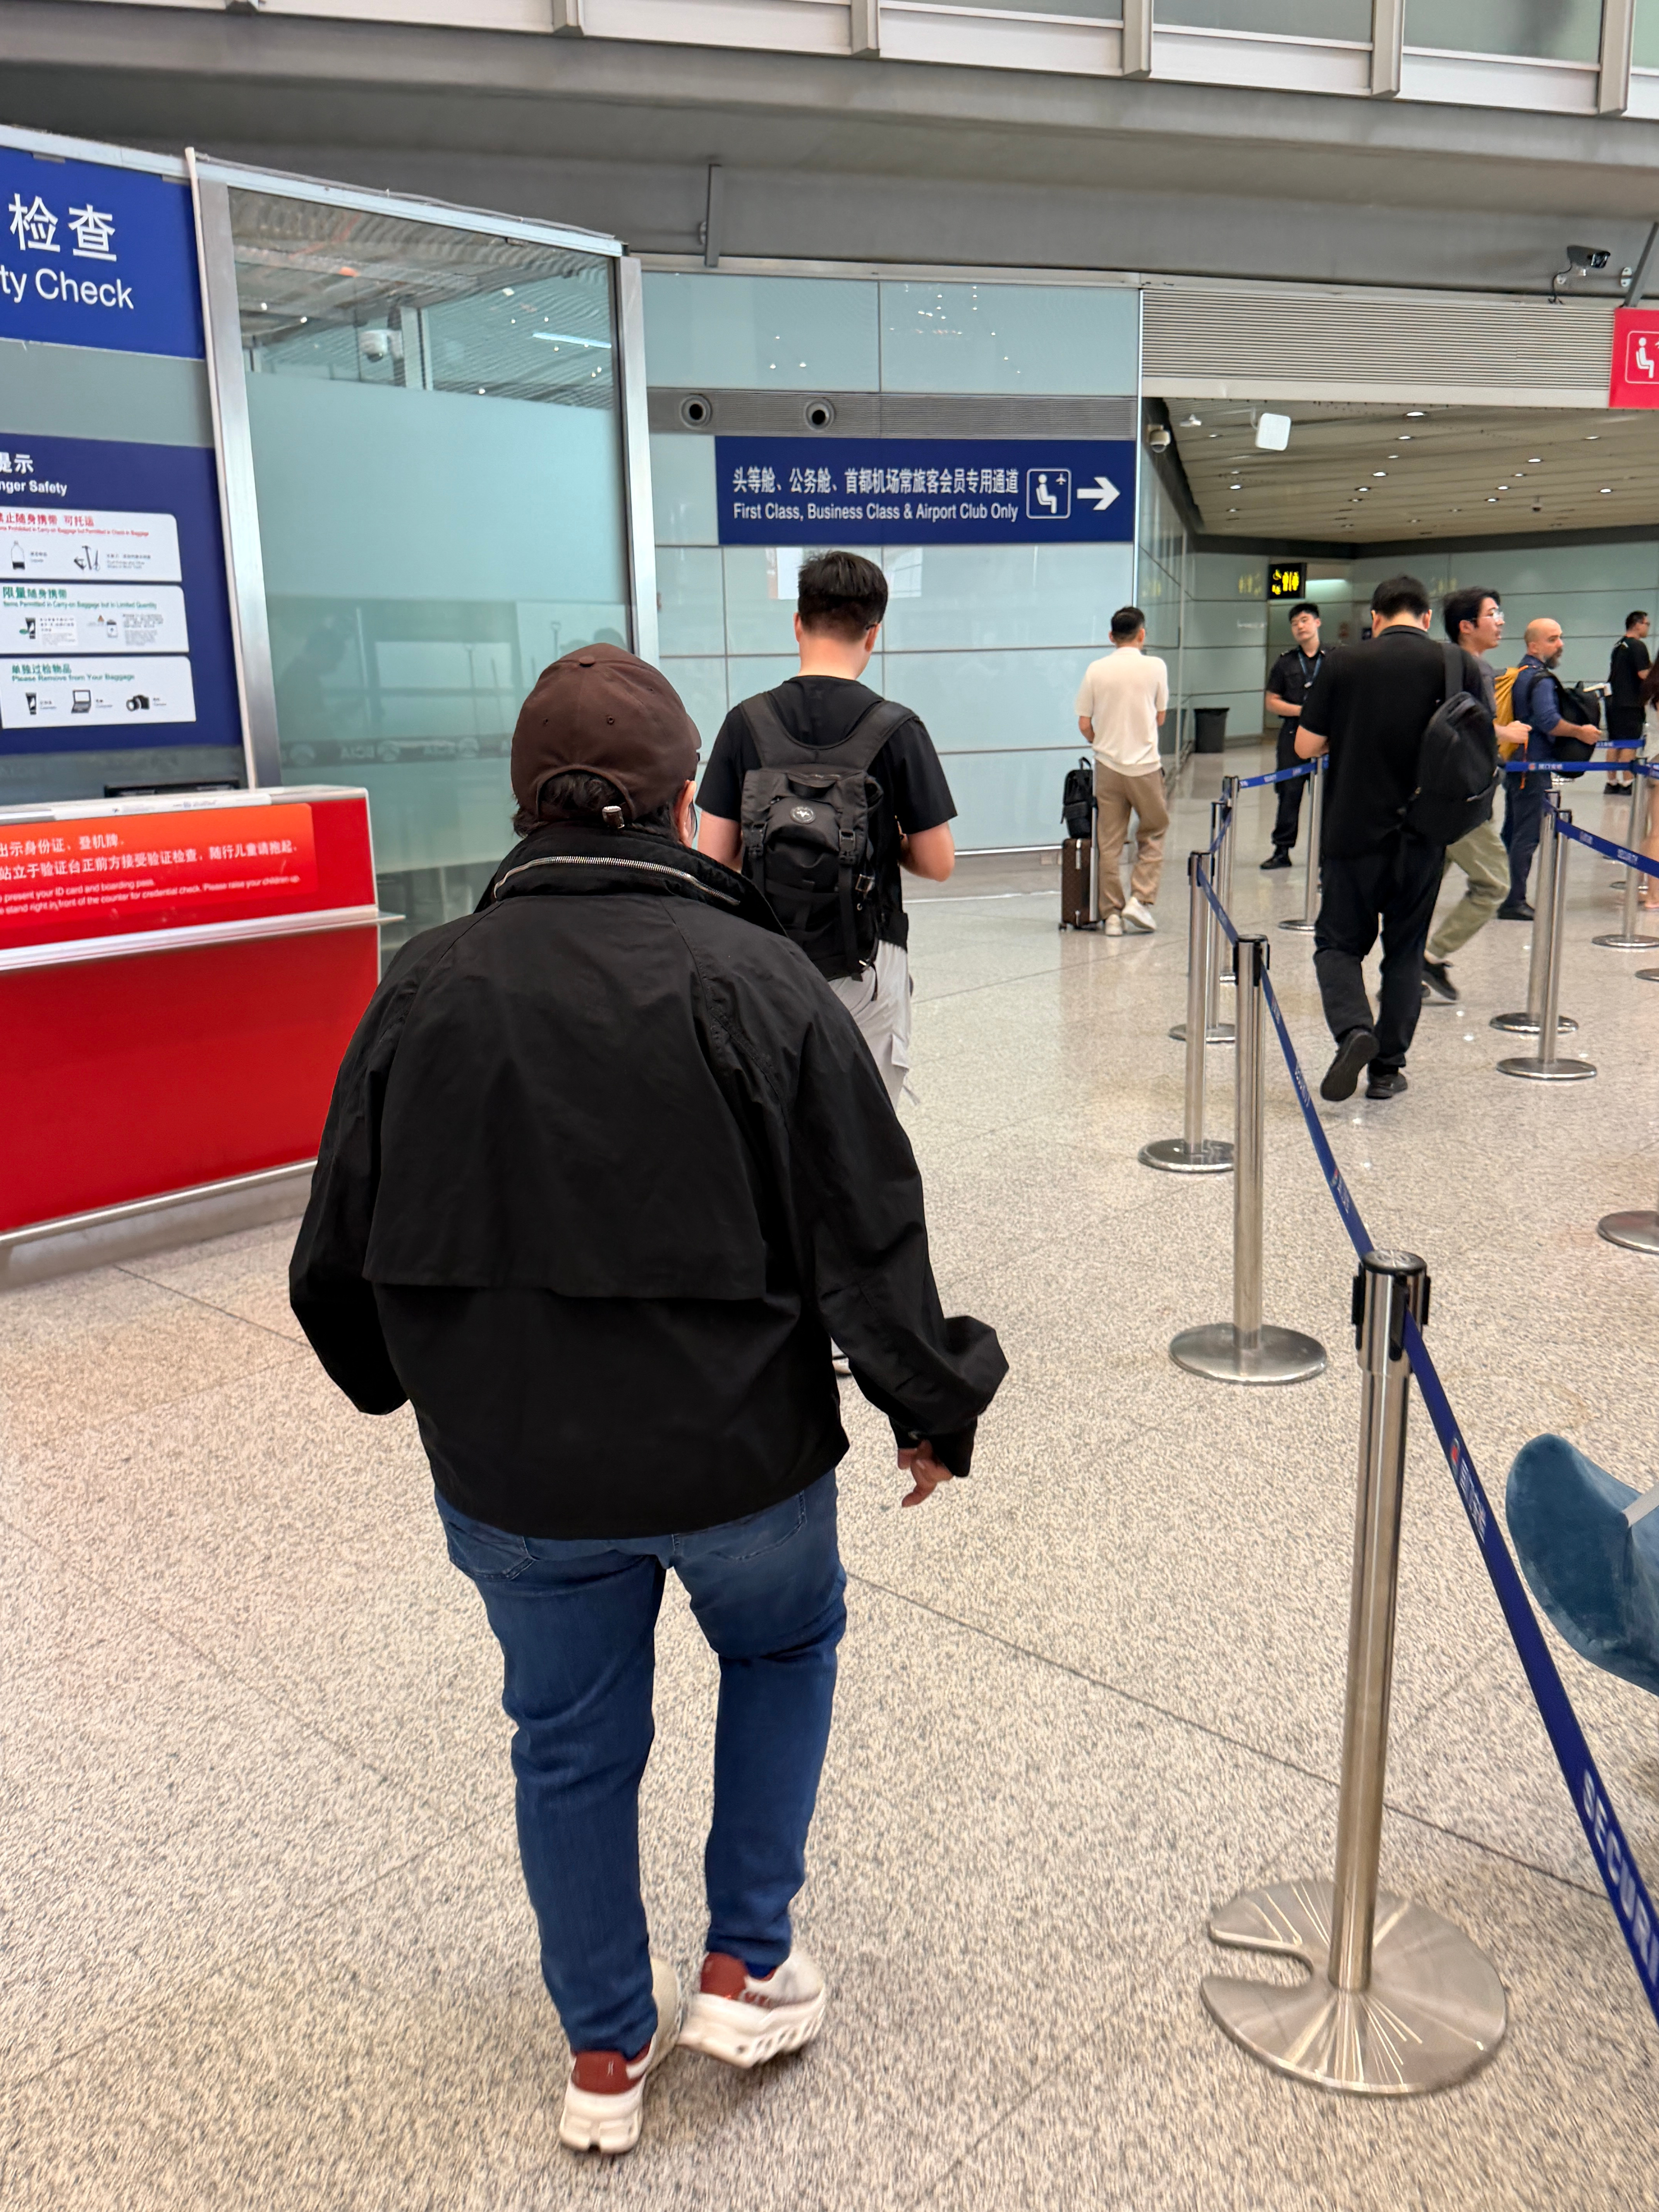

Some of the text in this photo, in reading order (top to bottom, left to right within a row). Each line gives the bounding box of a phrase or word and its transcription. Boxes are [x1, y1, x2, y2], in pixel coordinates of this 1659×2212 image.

[8, 193, 117, 261] 检查
[0, 264, 134, 309] ty Check
[29, 480, 67, 497] Safety
[733, 465, 1018, 494] 头等舱、公务舱、首都机场常旅客会员专用通道
[733, 502, 1018, 523] First Class, Business Class & Airport Club Only
[36, 888, 53, 900] your
[55, 887, 64, 896] ID
[66, 885, 83, 895] card
[84, 883, 100, 893] and
